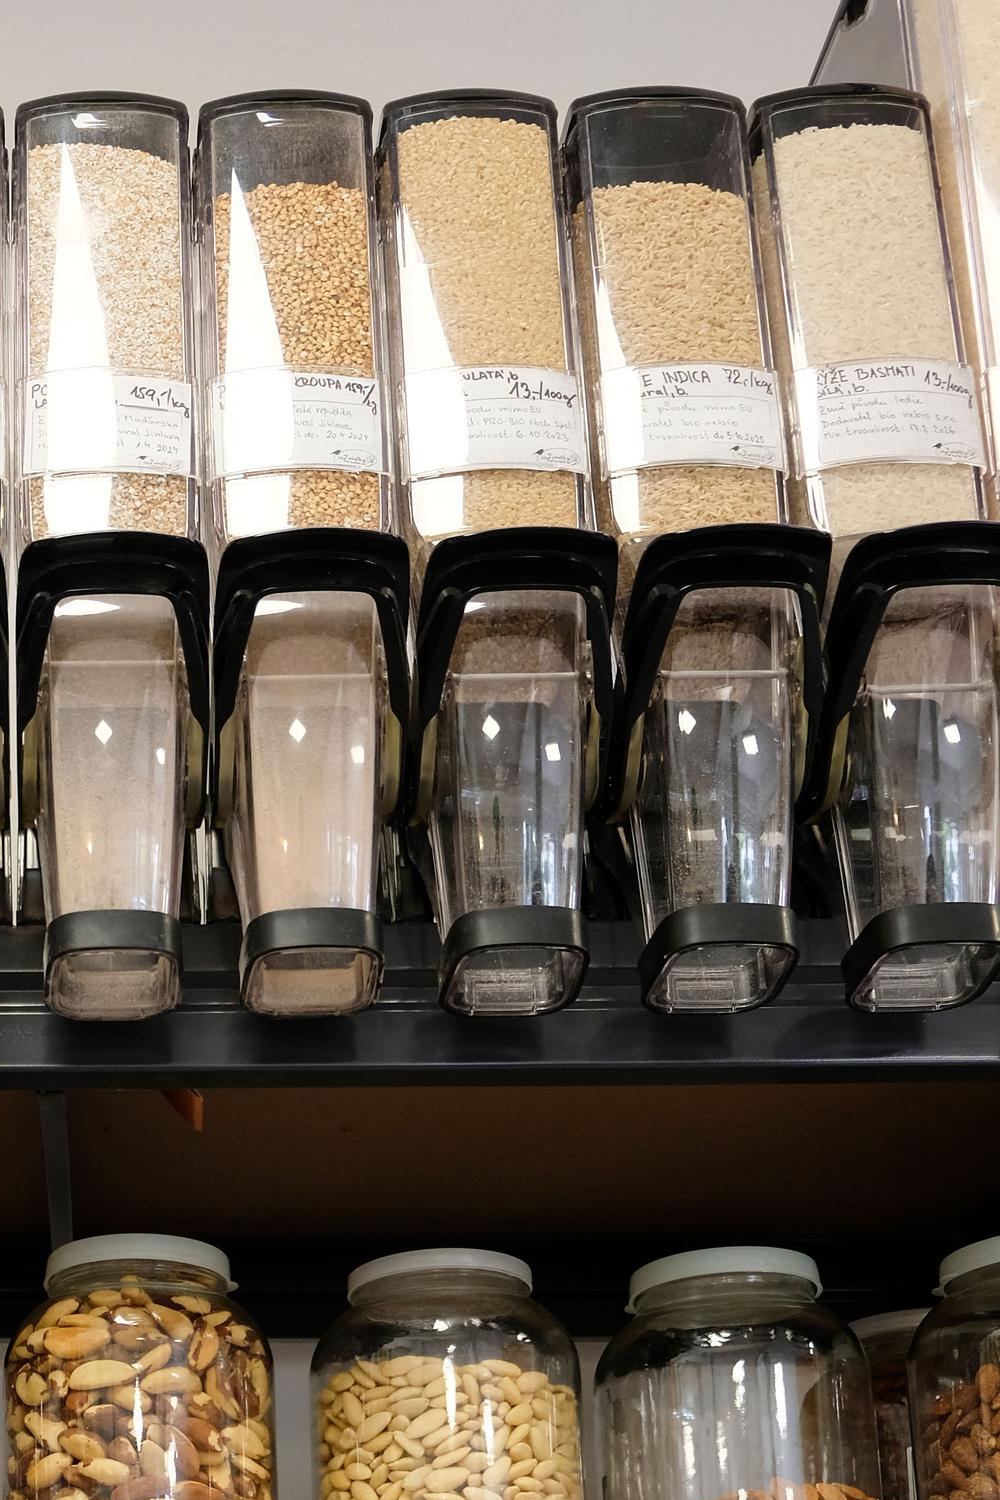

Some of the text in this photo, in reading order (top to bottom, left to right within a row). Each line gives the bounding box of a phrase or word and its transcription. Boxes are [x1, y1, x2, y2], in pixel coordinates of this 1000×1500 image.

[661, 370, 711, 386] INDICA
[854, 365, 916, 382] BASMATI
[294, 376, 342, 391] KROUPA
